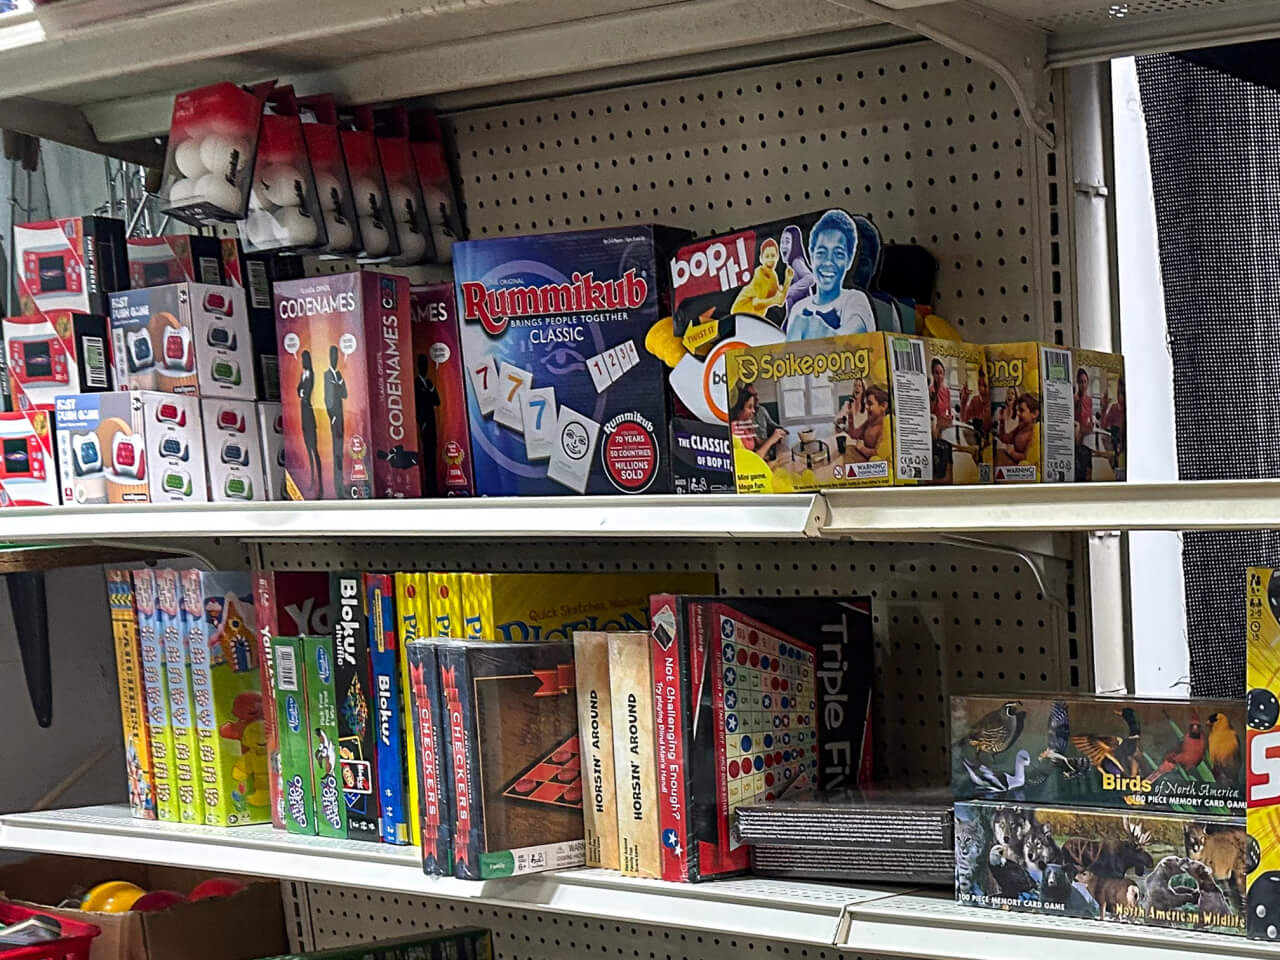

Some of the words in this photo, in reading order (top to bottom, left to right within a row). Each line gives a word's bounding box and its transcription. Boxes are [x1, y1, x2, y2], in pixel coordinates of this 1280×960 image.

[670, 239, 727, 289] bop
[280, 292, 355, 319] CODENAMES
[462, 268, 648, 335] Rummikub
[511, 317, 543, 328] BRINGS
[545, 315, 578, 326] PEOPLE
[581, 312, 629, 323] TOGETHER
[530, 327, 585, 344] CLASSIC
[384, 315, 404, 440] CODENAMES
[759, 350, 870, 381] Spikepong
[615, 461, 649, 470] MILLIONS
[621, 470, 644, 480] SOLD
[665, 657, 674, 682] Not
[817, 613, 849, 730] Triple
[377, 675, 391, 747] Blokus
[627, 693, 639, 755] AROUND
[420, 708, 437, 816] CHECKERS
[452, 712, 468, 820] CHECKERS
[630, 760, 643, 821] HORSIN'
[668, 764, 681, 820] Enough?
[1102, 772, 1153, 792] Birds
[1153, 780, 1165, 796] of
[1165, 782, 1198, 796] North
[1199, 784, 1241, 799] America
[1147, 795, 1167, 804] PIECE
[1168, 796, 1202, 807] MEMORY
[1203, 798, 1225, 808] CARD
[972, 894, 990, 904] PIECE
[991, 896, 1022, 908] MEMORY
[1023, 899, 1043, 909] CARD
[1044, 901, 1065, 911] GAME
[1116, 903, 1145, 919] North
[1148, 905, 1200, 923] American
[1203, 911, 1246, 929] Wildlife
